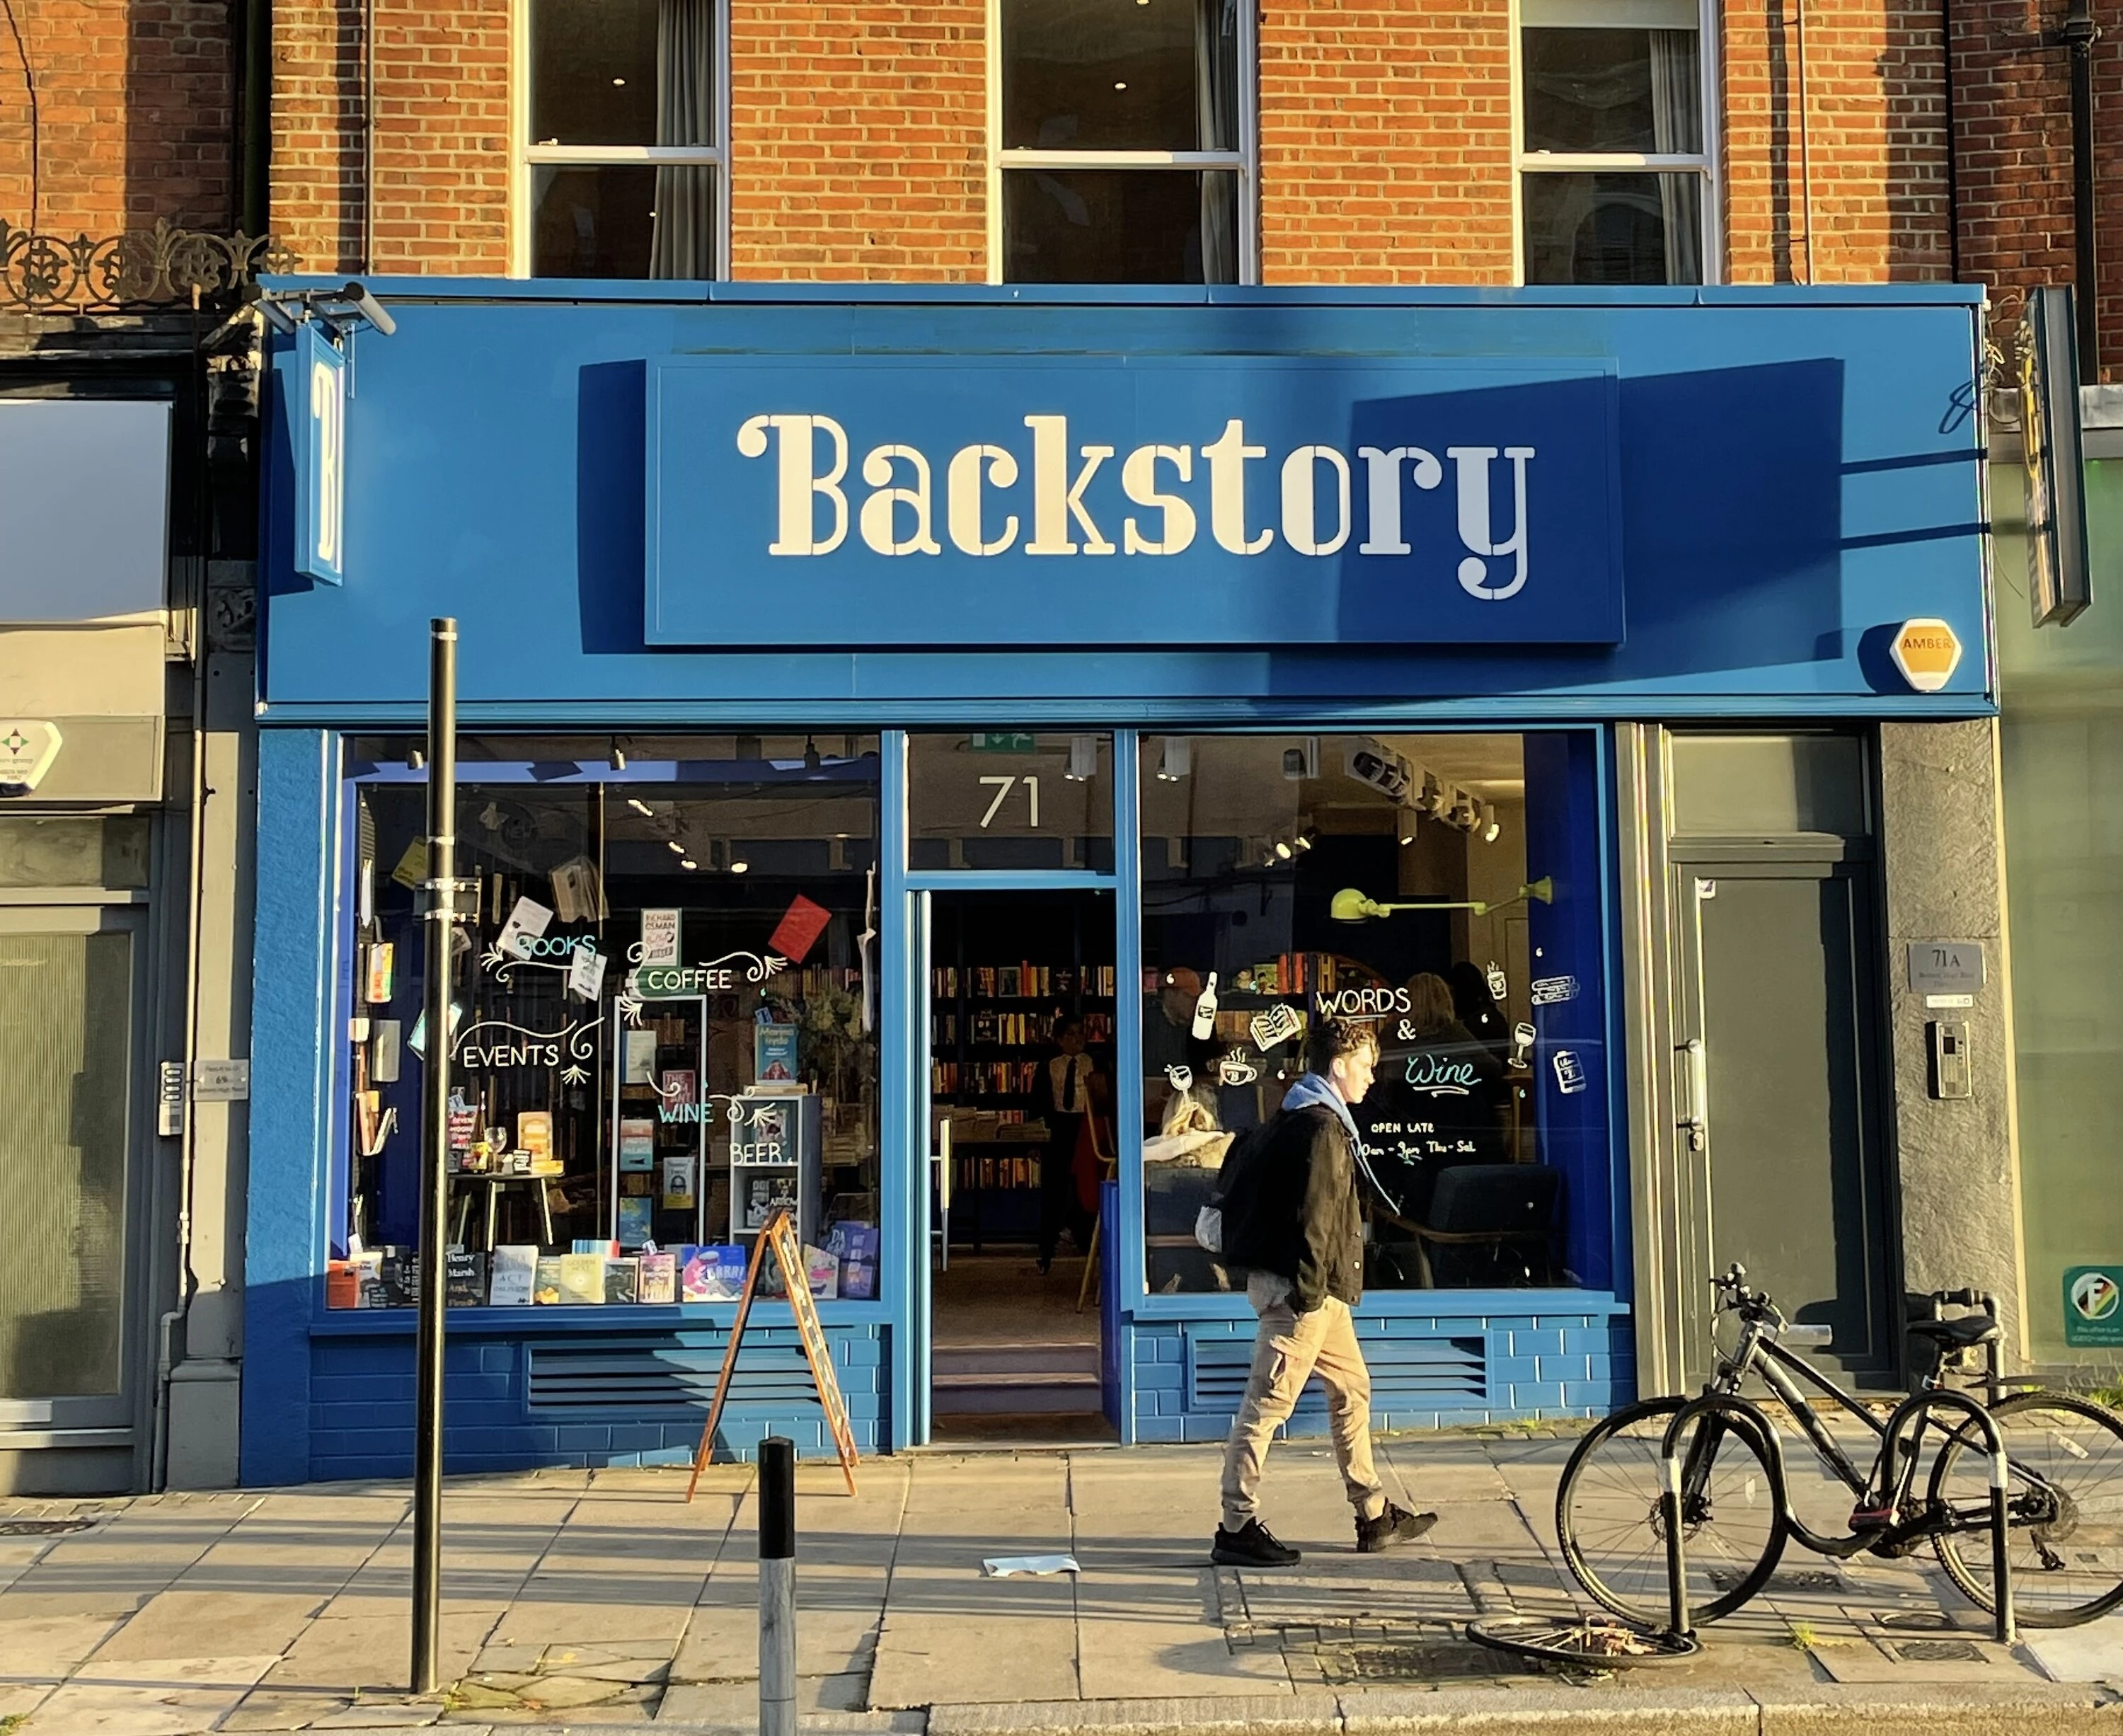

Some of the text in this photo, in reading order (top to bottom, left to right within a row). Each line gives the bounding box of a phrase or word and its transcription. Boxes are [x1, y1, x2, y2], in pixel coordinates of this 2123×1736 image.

[737, 414, 1536, 600] Backstory
[1902, 638, 1952, 650] AMBER
[979, 776, 1039, 829] 71
[516, 934, 597, 956] BOOKS
[1931, 948, 1961, 967] 71A
[648, 969, 732, 990] COFFEE
[1316, 987, 1412, 1014] WORDS
[1397, 1018, 1417, 1040] &
[463, 1044, 559, 1068] EVENTS
[1405, 1053, 1483, 1086] Wine
[657, 1103, 714, 1124] WINE
[1371, 1122, 1434, 1133] OPEN LATE
[730, 1142, 783, 1166] BEER
